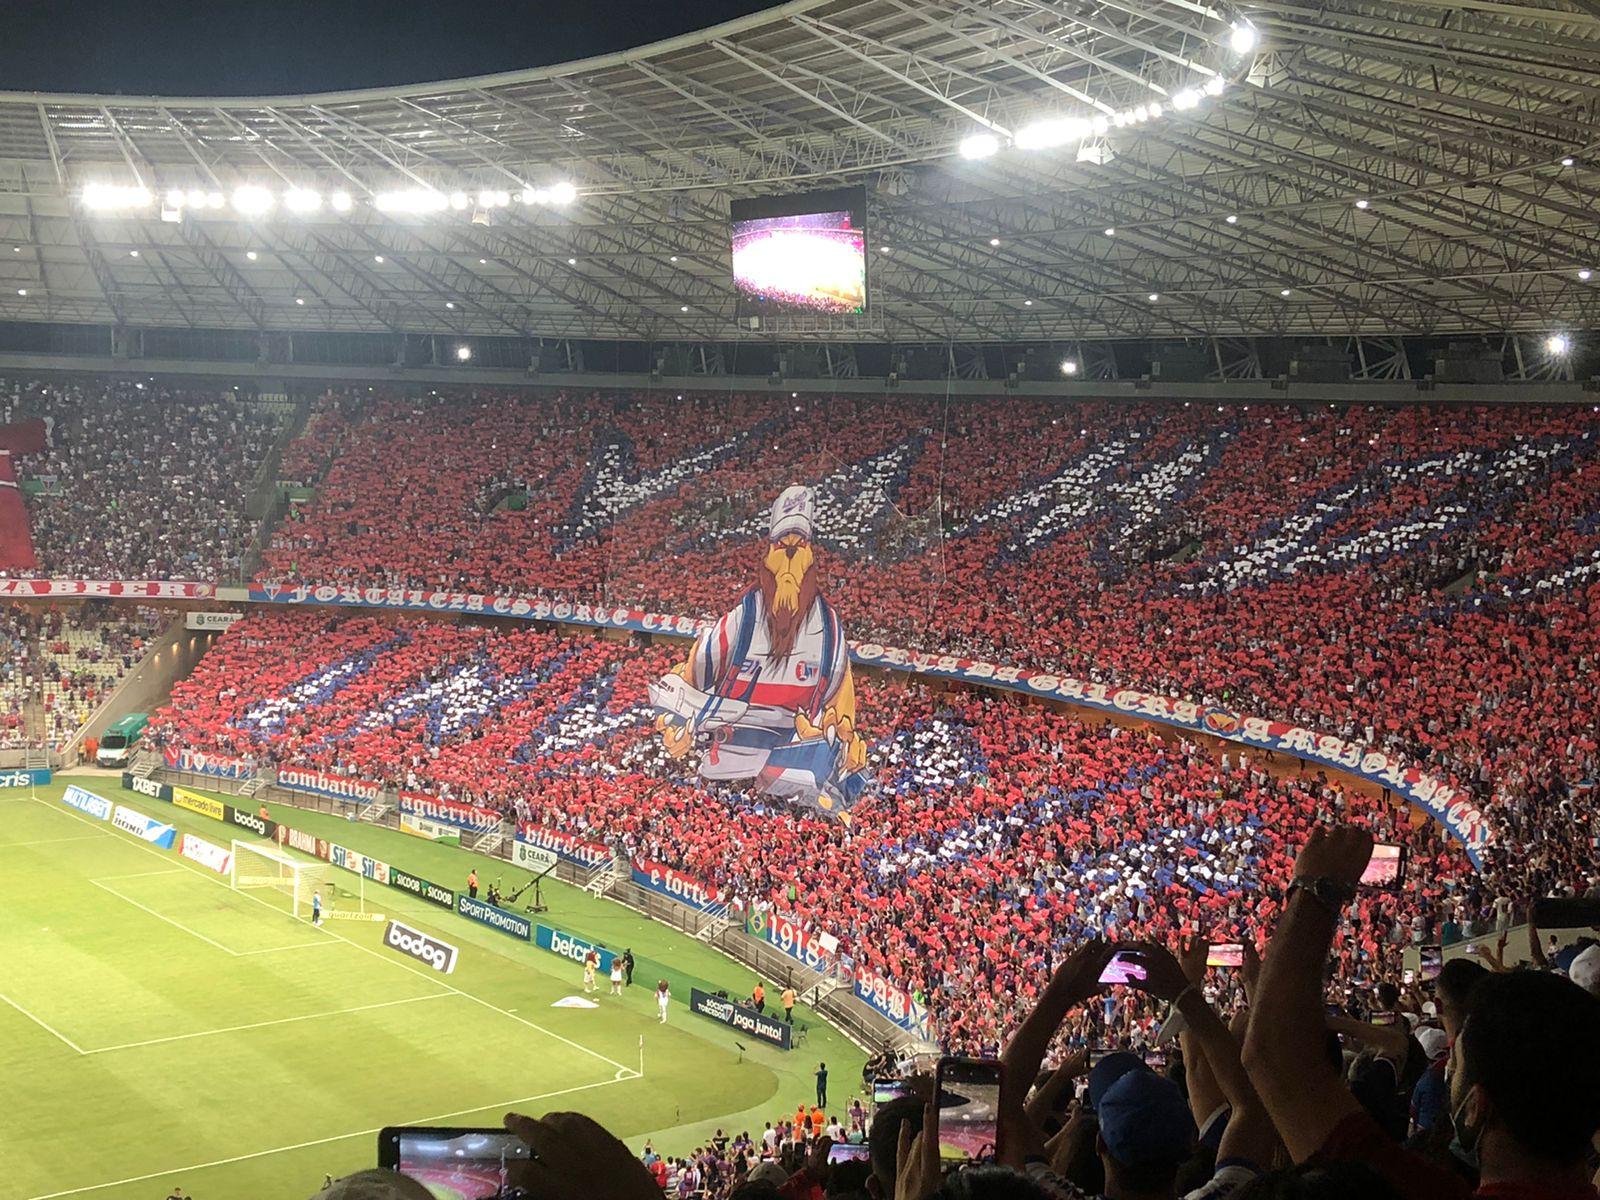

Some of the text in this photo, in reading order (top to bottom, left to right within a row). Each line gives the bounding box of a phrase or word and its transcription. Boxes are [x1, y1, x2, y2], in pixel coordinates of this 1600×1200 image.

[49, 581, 191, 596] BEER
[206, 614, 235, 623] CEARÁ
[288, 584, 486, 612] FORTALEZA
[492, 596, 630, 626] ESPORTE
[641, 612, 718, 638] CLUB
[132, 776, 163, 798] 1XBET
[278, 769, 379, 799] combativo
[183, 795, 222, 816] mercado livre
[401, 796, 498, 828] aguerrido
[234, 808, 265, 835] bodog
[288, 827, 316, 856] BRAHMA
[527, 850, 550, 863] CEARÁ
[333, 845, 375, 878] Sil Sil
[396, 873, 453, 905] SICOOB SICOOB
[650, 868, 661, 886] e
[388, 921, 447, 970] bodog
[550, 931, 602, 968] betcrs
[770, 914, 821, 967] 1918
[732, 1009, 782, 1040] joga junto!
